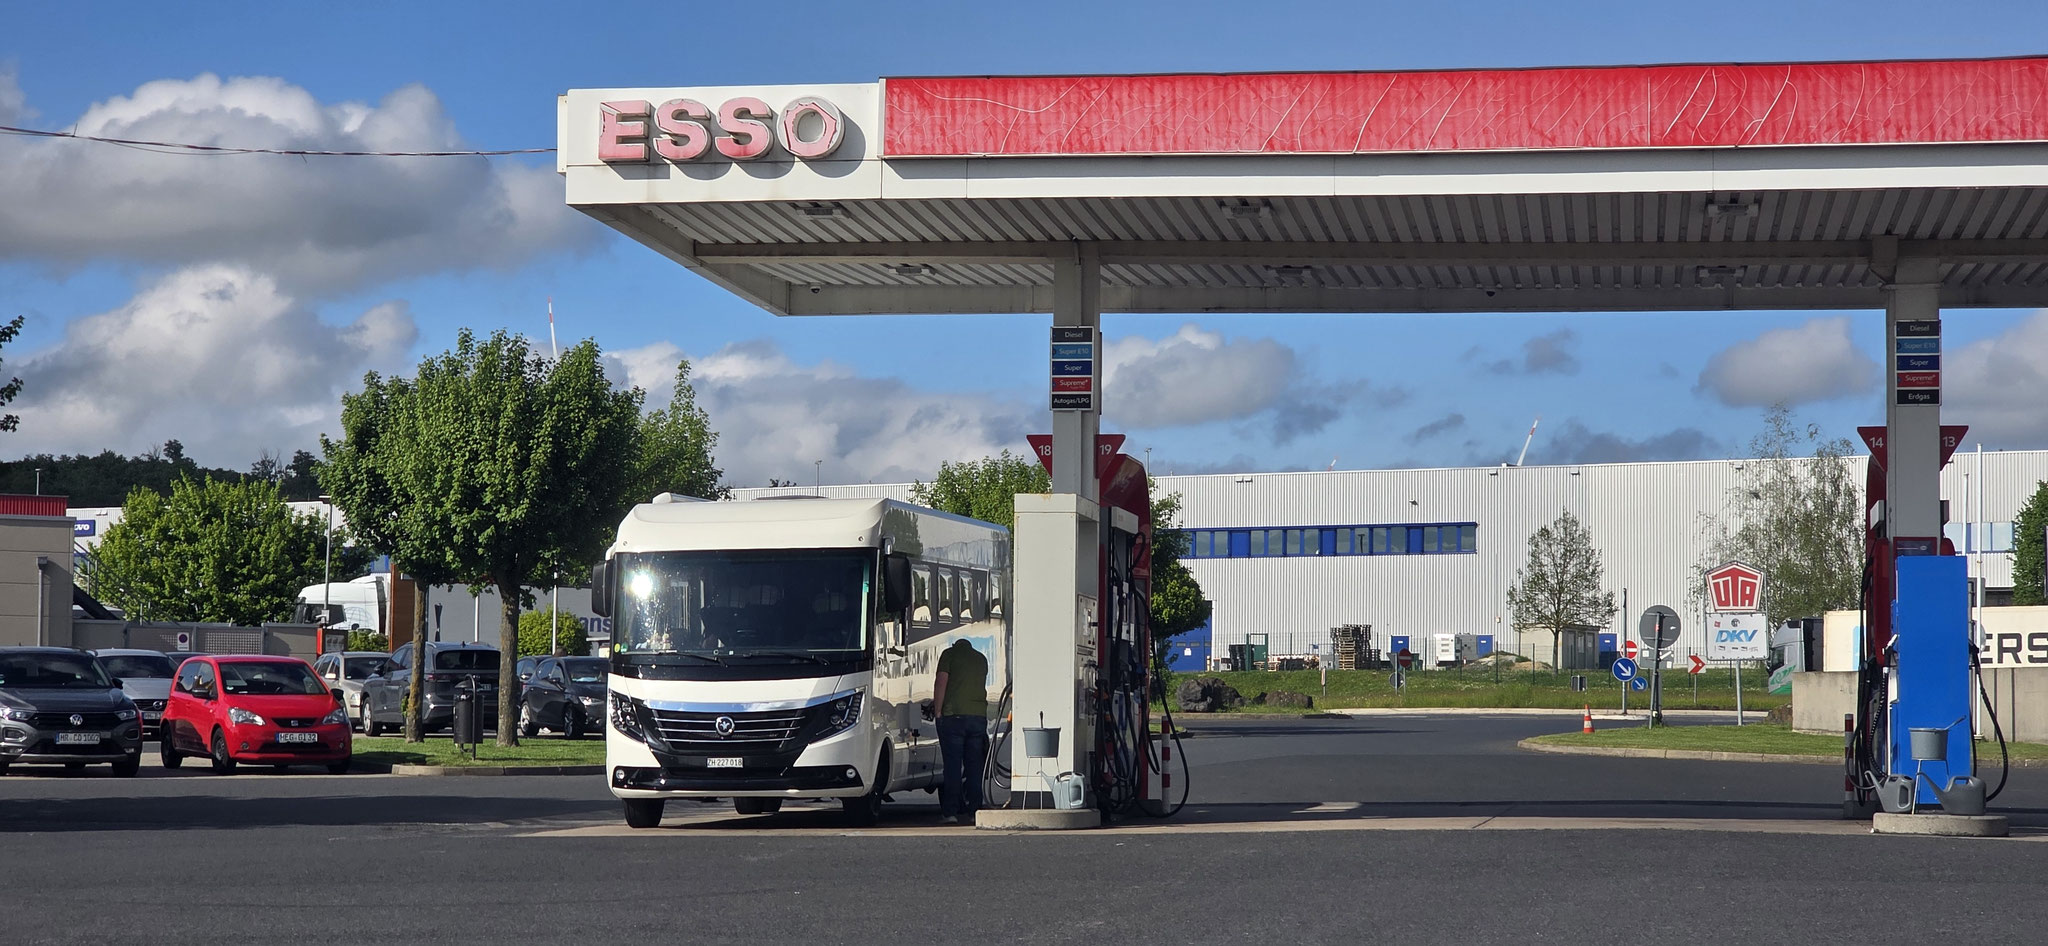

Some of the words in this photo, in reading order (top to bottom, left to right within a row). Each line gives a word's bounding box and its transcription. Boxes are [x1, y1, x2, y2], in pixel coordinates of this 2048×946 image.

[598, 95, 845, 161] ESSO
[1904, 342, 1922, 350] Super
[1059, 348, 1077, 356] Super
[1910, 359, 1929, 367] Super
[1053, 397, 1090, 405] Autogas/LPG
[1908, 393, 1930, 401] Erdgas
[1869, 437, 1884, 448] 14
[1942, 436, 1955, 447] 13
[1038, 445, 1051, 456] 18
[1099, 444, 1112, 455] 19
[1711, 567, 1759, 607] UTA
[1715, 629, 1759, 643] DKV
